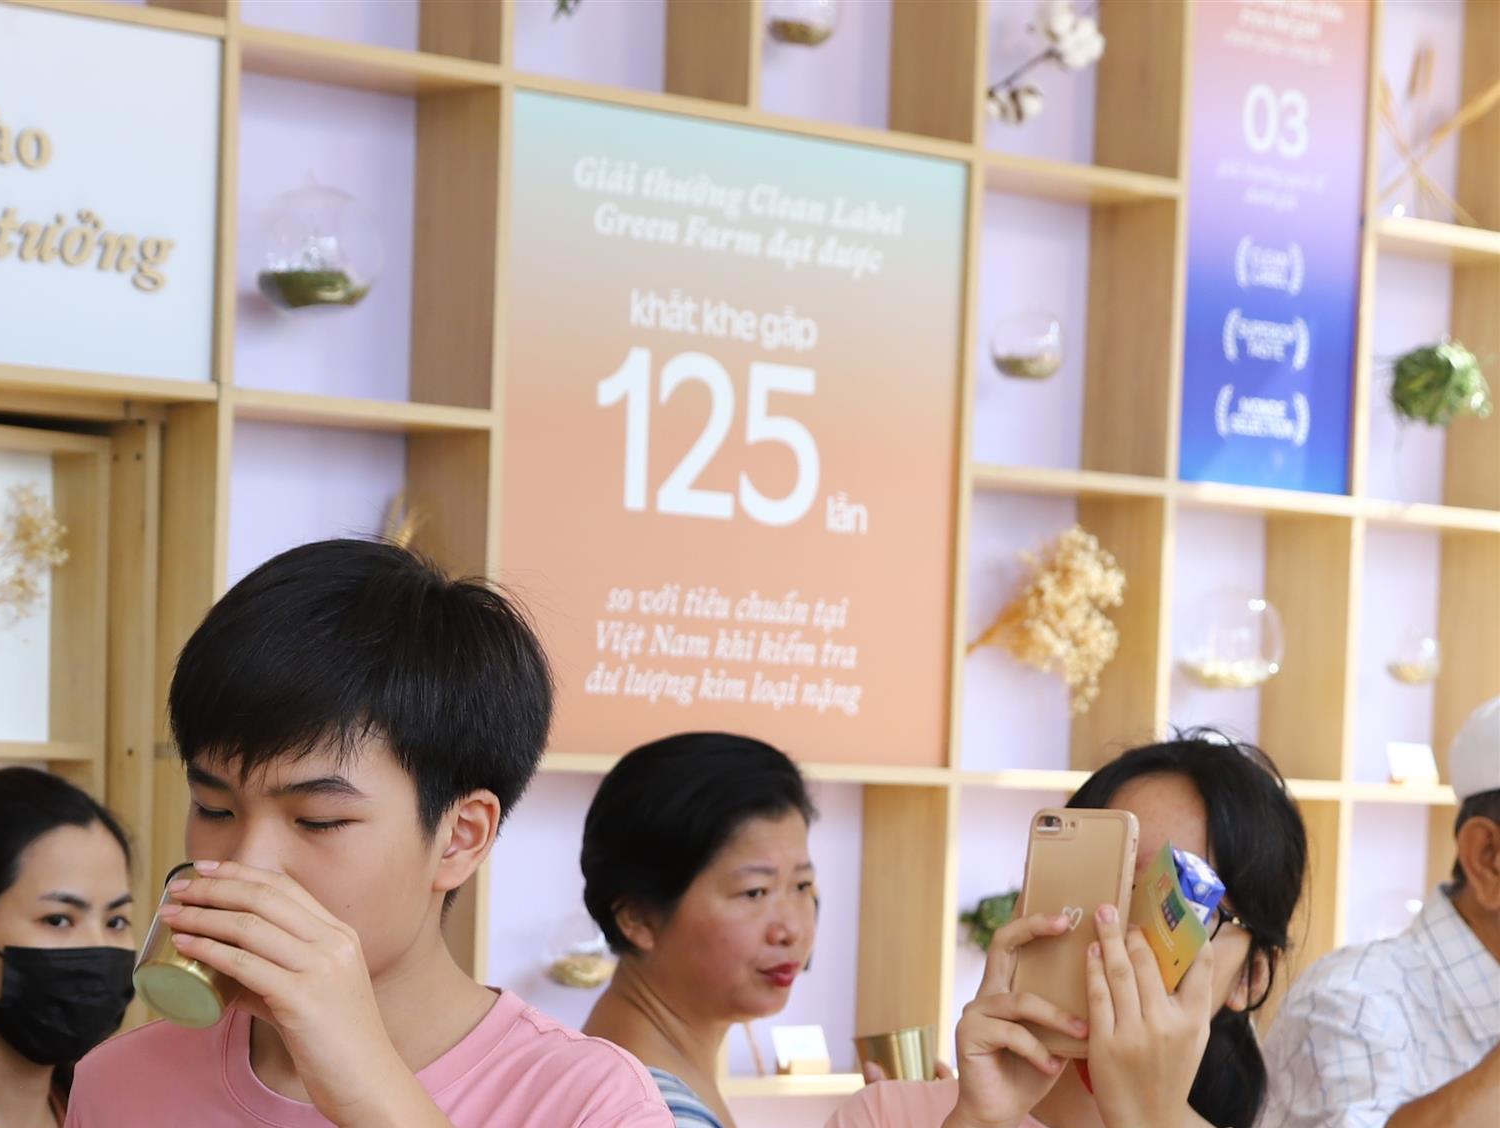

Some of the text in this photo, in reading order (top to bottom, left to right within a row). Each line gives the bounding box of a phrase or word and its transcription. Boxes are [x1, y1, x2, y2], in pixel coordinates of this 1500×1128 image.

[1242, 82, 1310, 159] 03
[593, 201, 680, 245] Green
[683, 214, 762, 258] Farm
[747, 182, 828, 226] Clean
[829, 196, 906, 238] Label
[702, 299, 757, 341] khe
[596, 345, 820, 528] 125
[605, 587, 633, 613] so
[638, 584, 681, 615] với
[596, 620, 647, 661] Việt
[648, 624, 710, 659] Nam
[714, 627, 757, 662] khi
[819, 639, 859, 669] tra
[698, 668, 747, 702] kim
